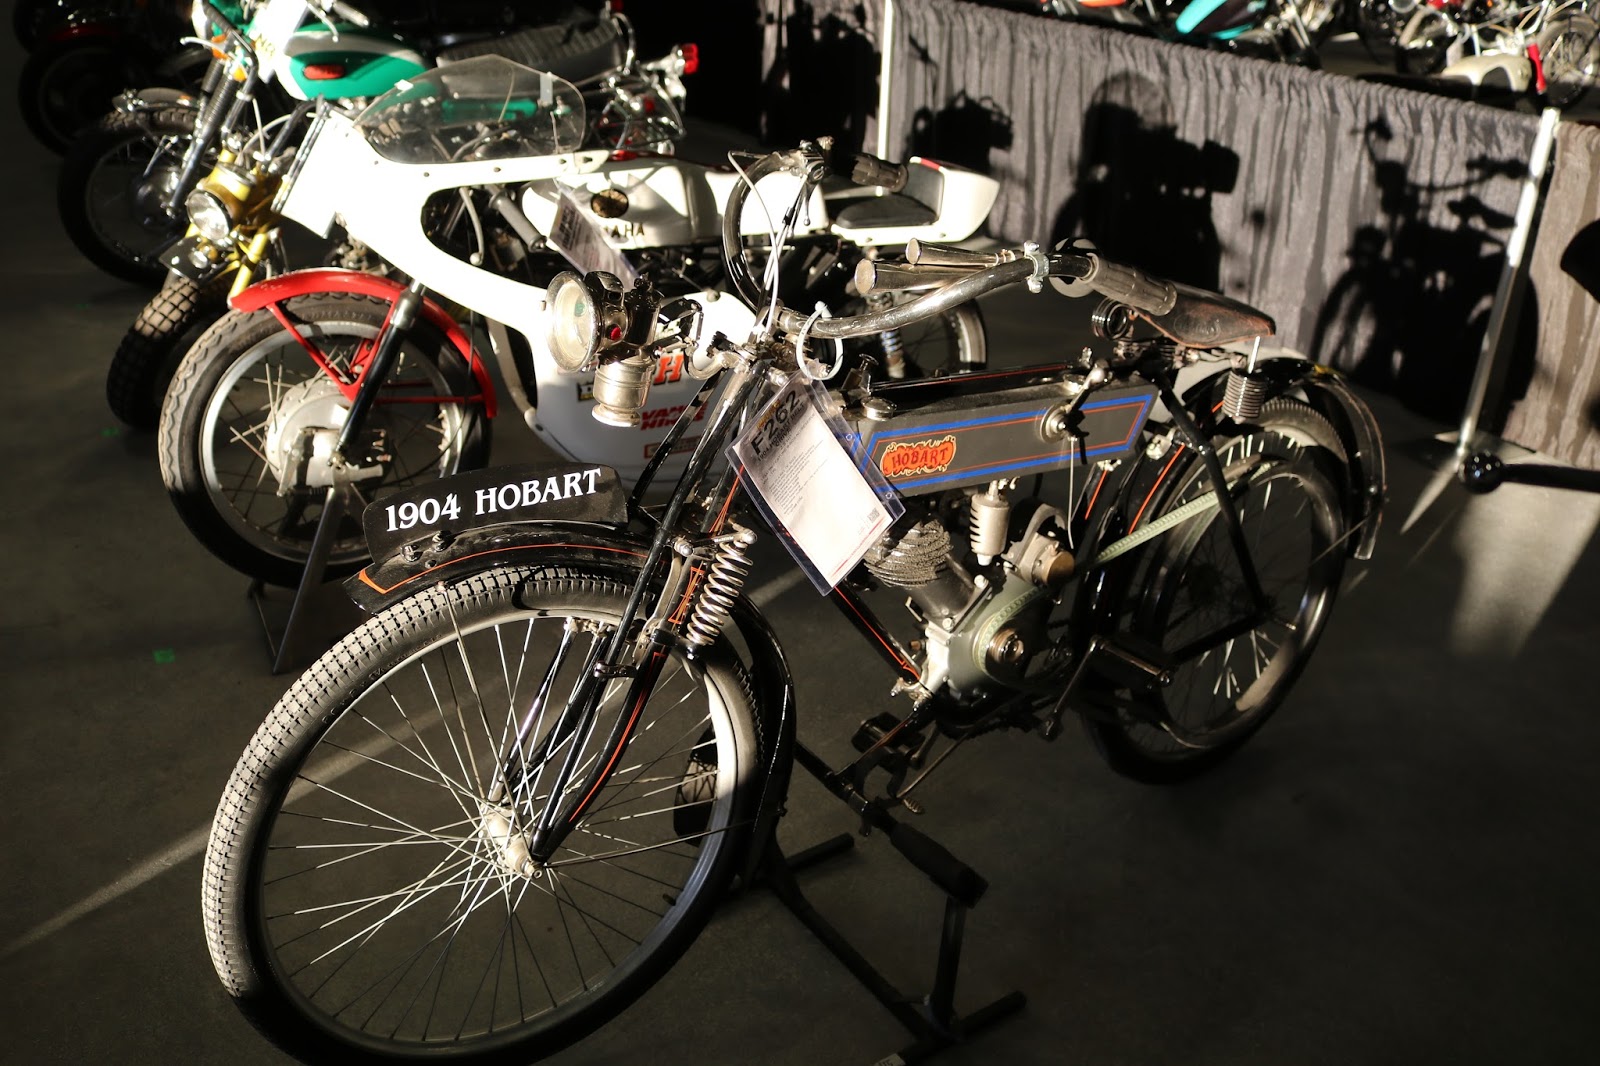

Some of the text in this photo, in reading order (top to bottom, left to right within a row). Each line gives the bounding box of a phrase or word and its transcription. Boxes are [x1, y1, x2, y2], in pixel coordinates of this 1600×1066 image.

[749, 389, 801, 455] F262
[891, 446, 949, 468] HOBART
[385, 468, 601, 531] 1904 HOBART
